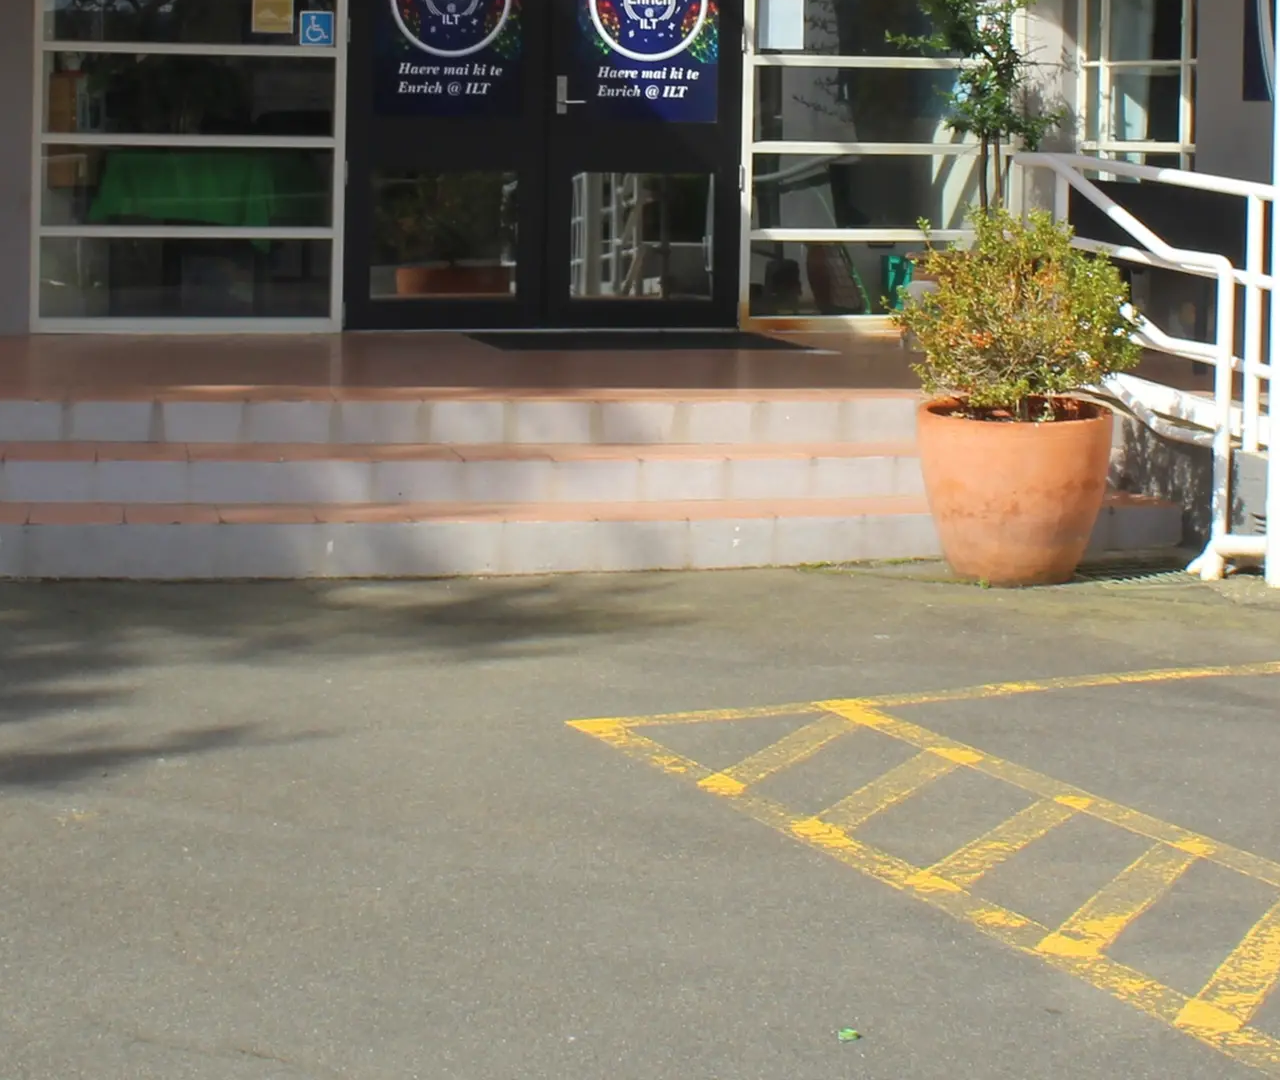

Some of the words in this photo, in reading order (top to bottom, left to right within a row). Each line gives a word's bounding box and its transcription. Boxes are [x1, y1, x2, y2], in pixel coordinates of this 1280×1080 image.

[441, 14, 461, 25] ILT
[639, 19, 659, 30] ILT
[398, 62, 440, 75] Haere
[443, 64, 469, 76] mai
[472, 63, 487, 76] ki
[489, 66, 503, 77] te
[597, 66, 638, 79] Haere
[641, 67, 667, 80] mai
[669, 67, 684, 80] ki
[686, 69, 700, 80] te
[397, 81, 442, 94] Enrich
[446, 81, 462, 96] @
[465, 82, 491, 94] ILT
[597, 84, 641, 97] Enrich
[644, 84, 660, 99] @
[662, 86, 689, 98] ILT
